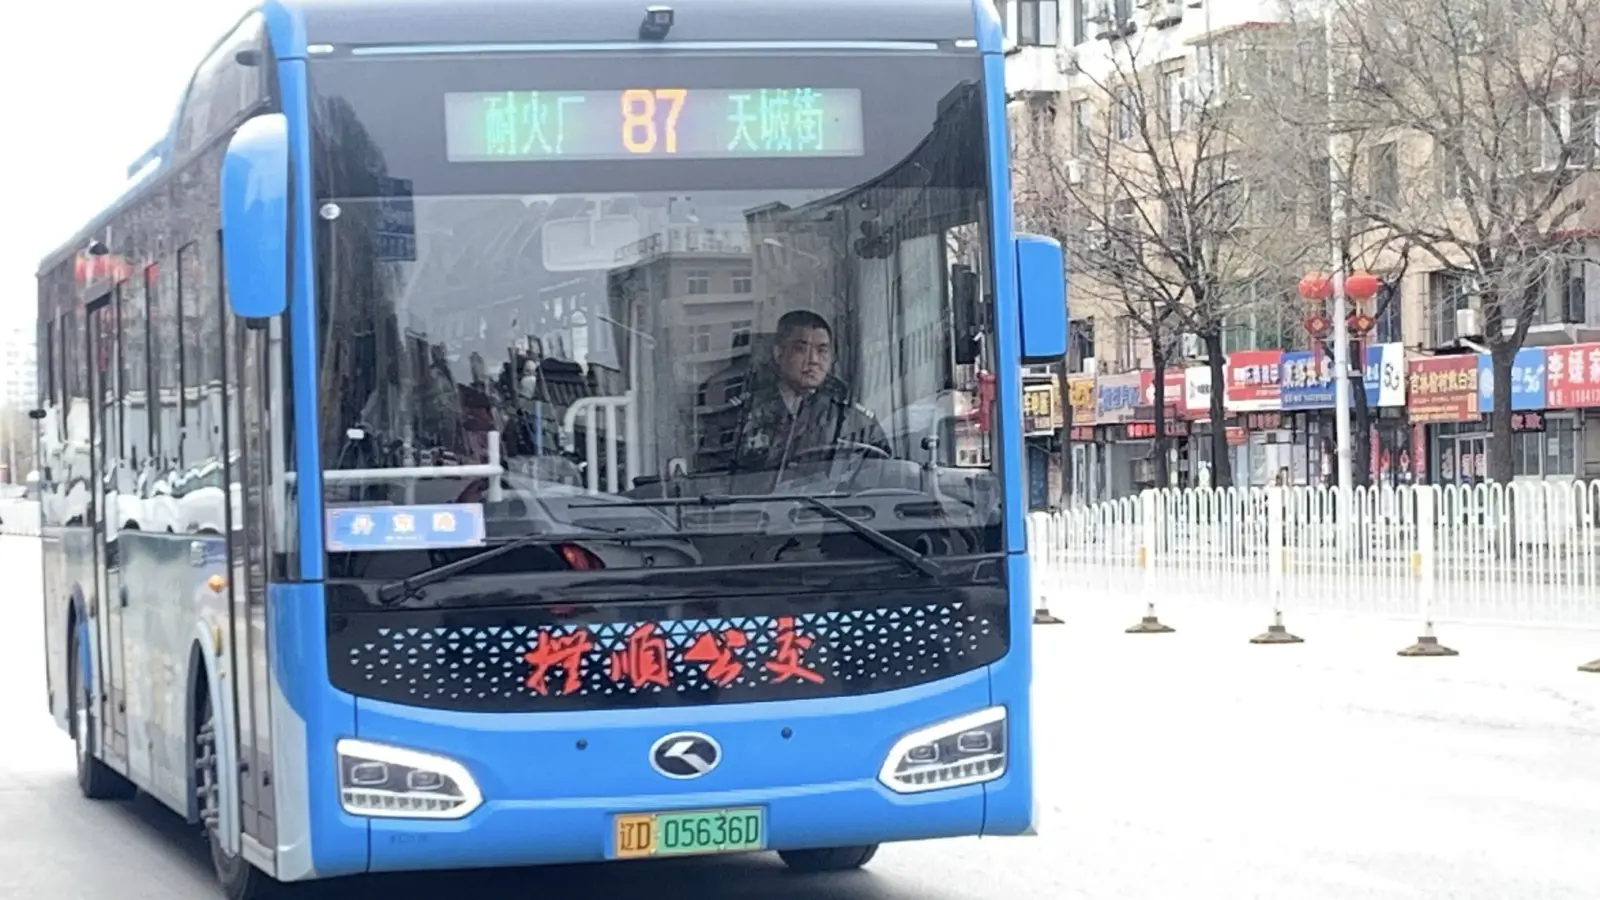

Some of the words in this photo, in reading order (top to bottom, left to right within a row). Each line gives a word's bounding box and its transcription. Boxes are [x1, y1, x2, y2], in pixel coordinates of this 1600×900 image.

[483, 90, 586, 157] 耐火厂
[618, 87, 688, 155] 87
[726, 86, 824, 153] 天城街
[664, 814, 760, 848] 05636D
